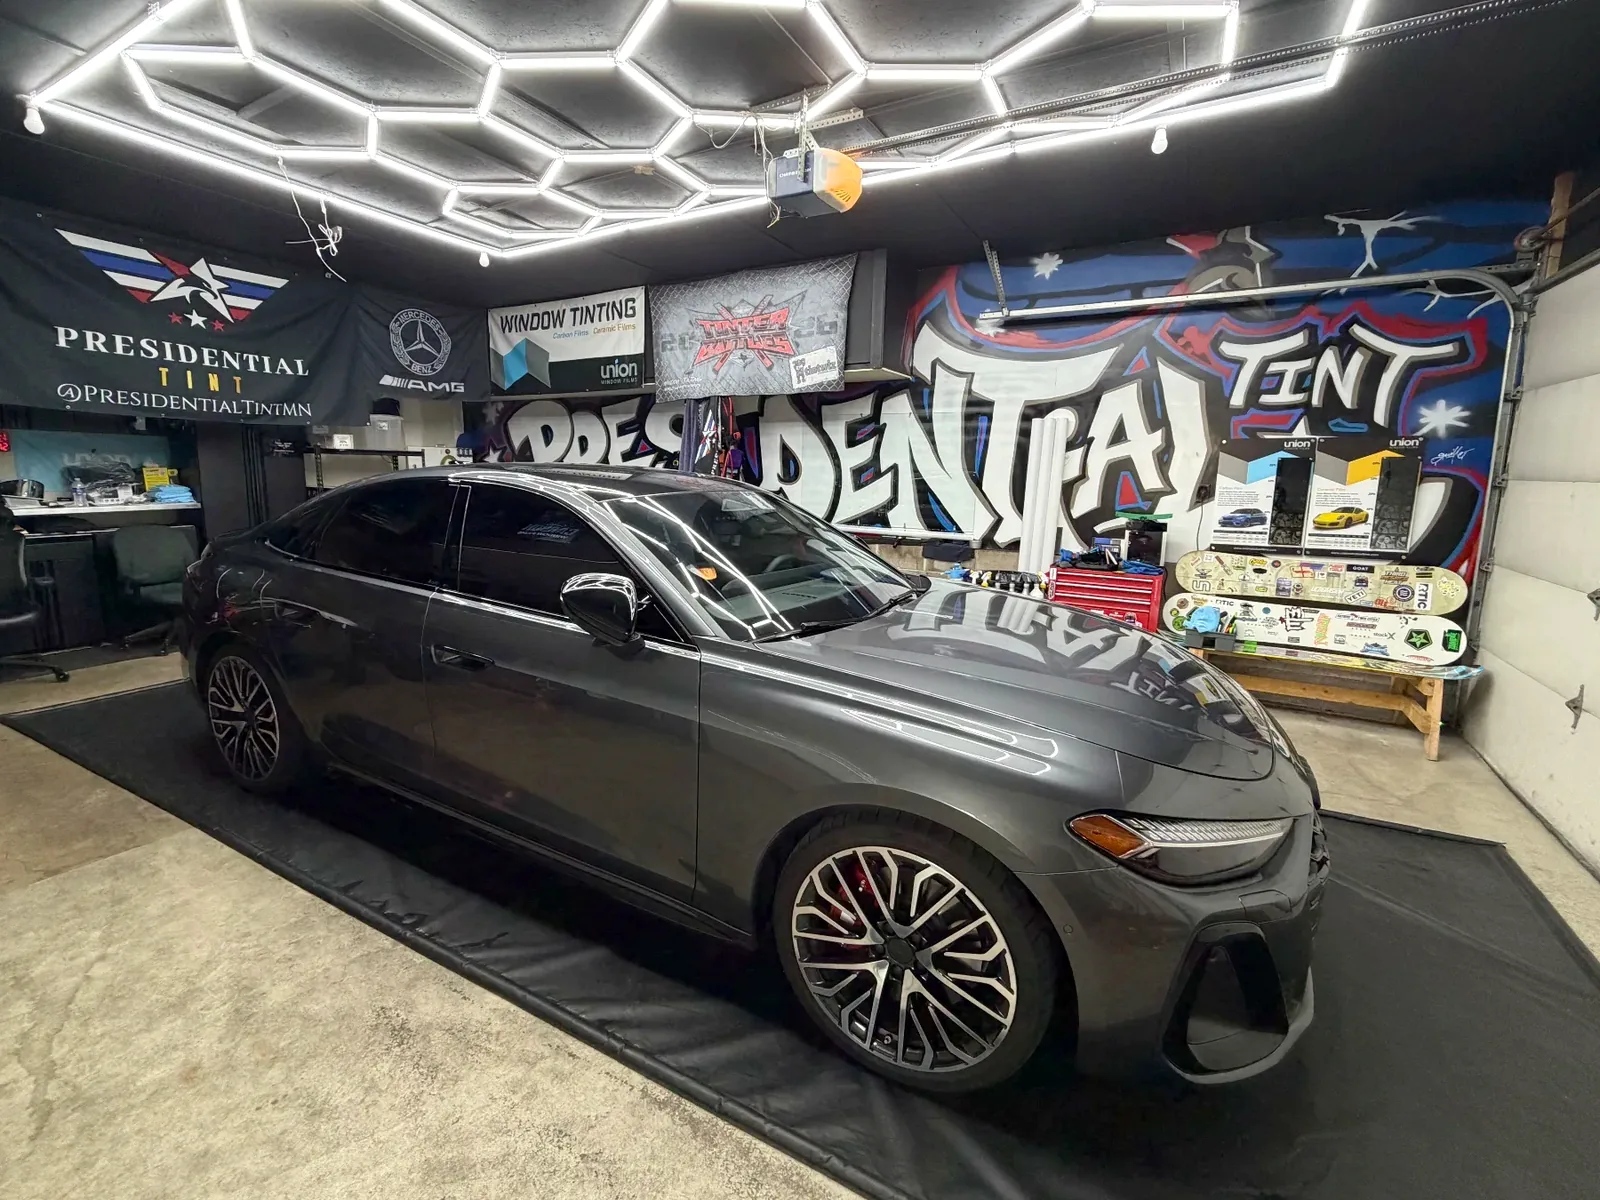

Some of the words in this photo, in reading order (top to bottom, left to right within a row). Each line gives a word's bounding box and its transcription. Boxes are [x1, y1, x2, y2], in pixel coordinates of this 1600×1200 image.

[398, 311, 441, 331] MERCEDES
[500, 308, 567, 334] WINDOW
[570, 297, 637, 327] TINTING
[552, 331, 573, 340] Carbon
[574, 329, 589, 338] Films
[593, 326, 616, 335] Ceramic
[617, 323, 636, 332] Films
[53, 325, 310, 377] PRESIDENTIAL
[411, 363, 433, 374] BENZ
[600, 358, 638, 379] union
[1218, 323, 1460, 428] TINT
[158, 367, 242, 394] TINT
[407, 379, 465, 393] AMG
[1284, 439, 1310, 448] union
[1389, 437, 1420, 447] union
[1347, 591, 1364, 602] YETI
[1417, 583, 1429, 609] RTIC
